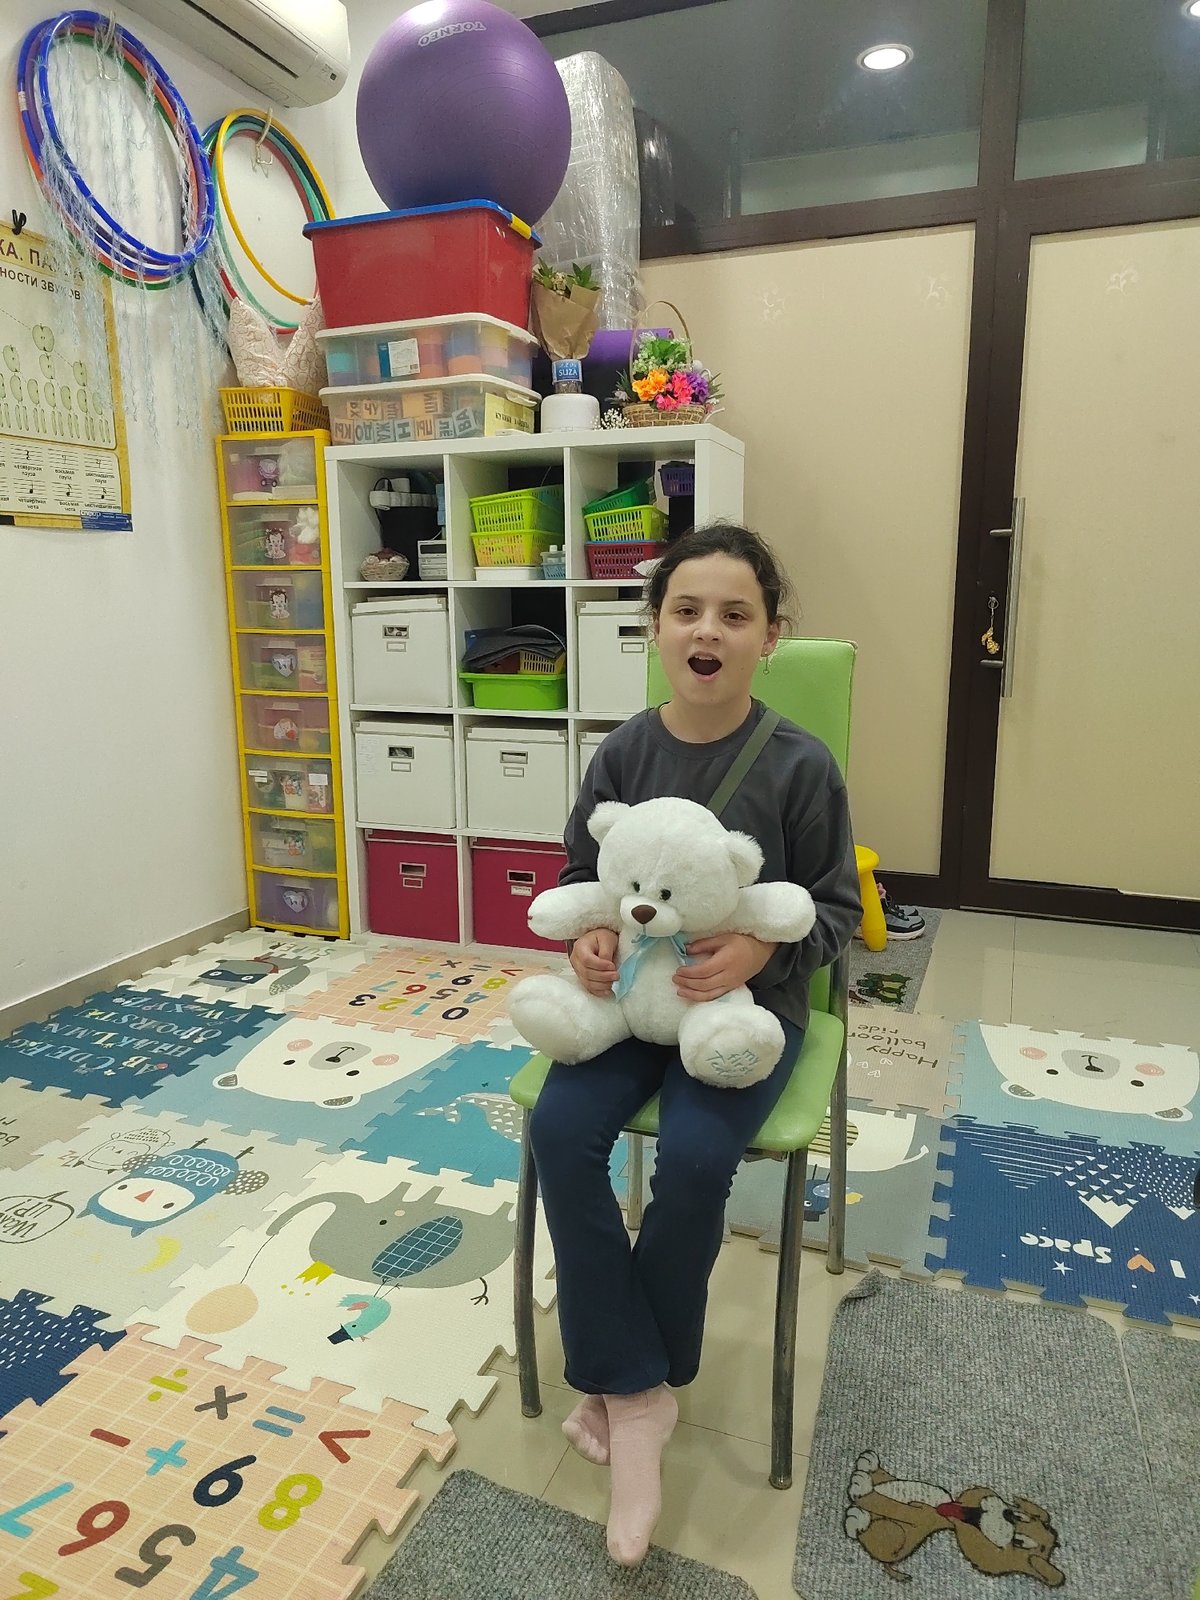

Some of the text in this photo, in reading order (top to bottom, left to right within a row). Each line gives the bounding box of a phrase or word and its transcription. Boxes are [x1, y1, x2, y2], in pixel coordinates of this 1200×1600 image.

[418, 20, 487, 47] TORNEO
[858, 1024, 898, 1034] ride
[866, 1045, 938, 1069] Happy
[0, 1482, 74, 1538] 7
[257, 1473, 323, 1531] 8
[114, 1523, 196, 1588] 5
